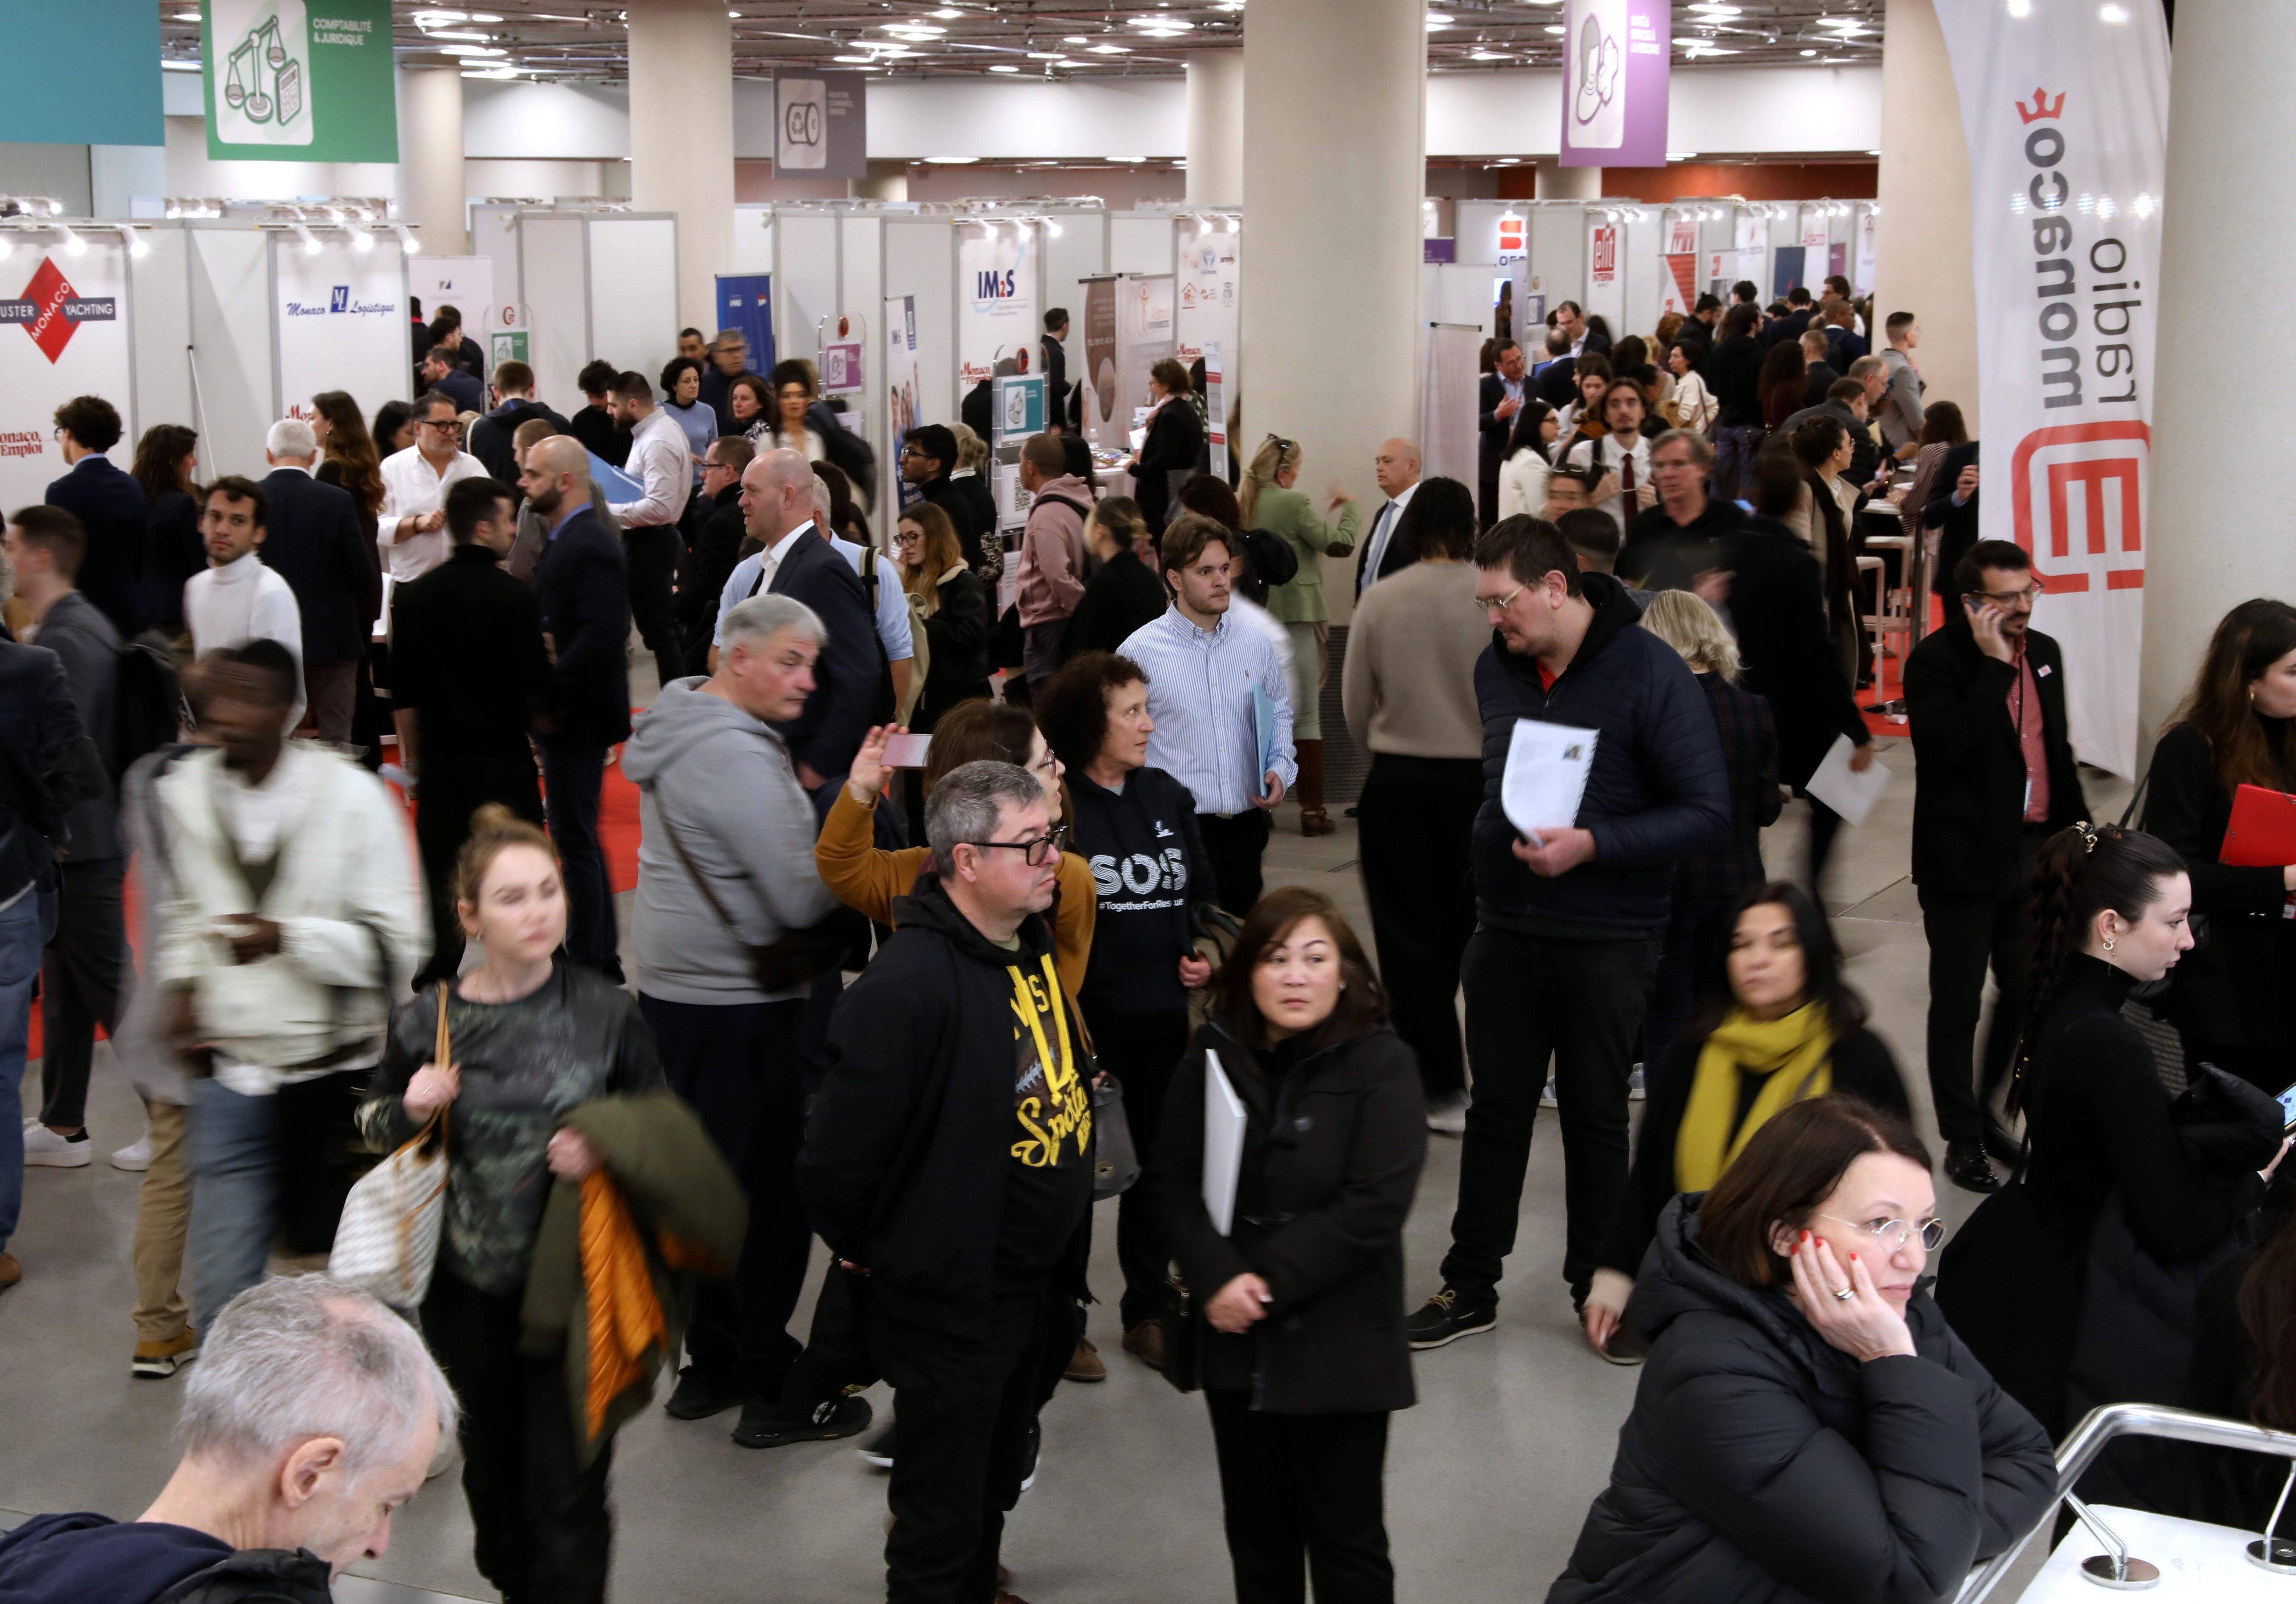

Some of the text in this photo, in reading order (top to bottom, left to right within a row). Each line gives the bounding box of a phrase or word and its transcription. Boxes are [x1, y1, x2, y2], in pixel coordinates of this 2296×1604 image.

[314, 31, 365, 45] & JURIDIQUE
[978, 269, 1014, 298] IM2S
[31, 282, 69, 340] MONACO
[64, 304, 113, 315] YACHTING
[287, 300, 394, 317] Monaco Logistique
[1089, 848, 1187, 895] SOS
[1098, 898, 1185, 912] #TogetherForResue
